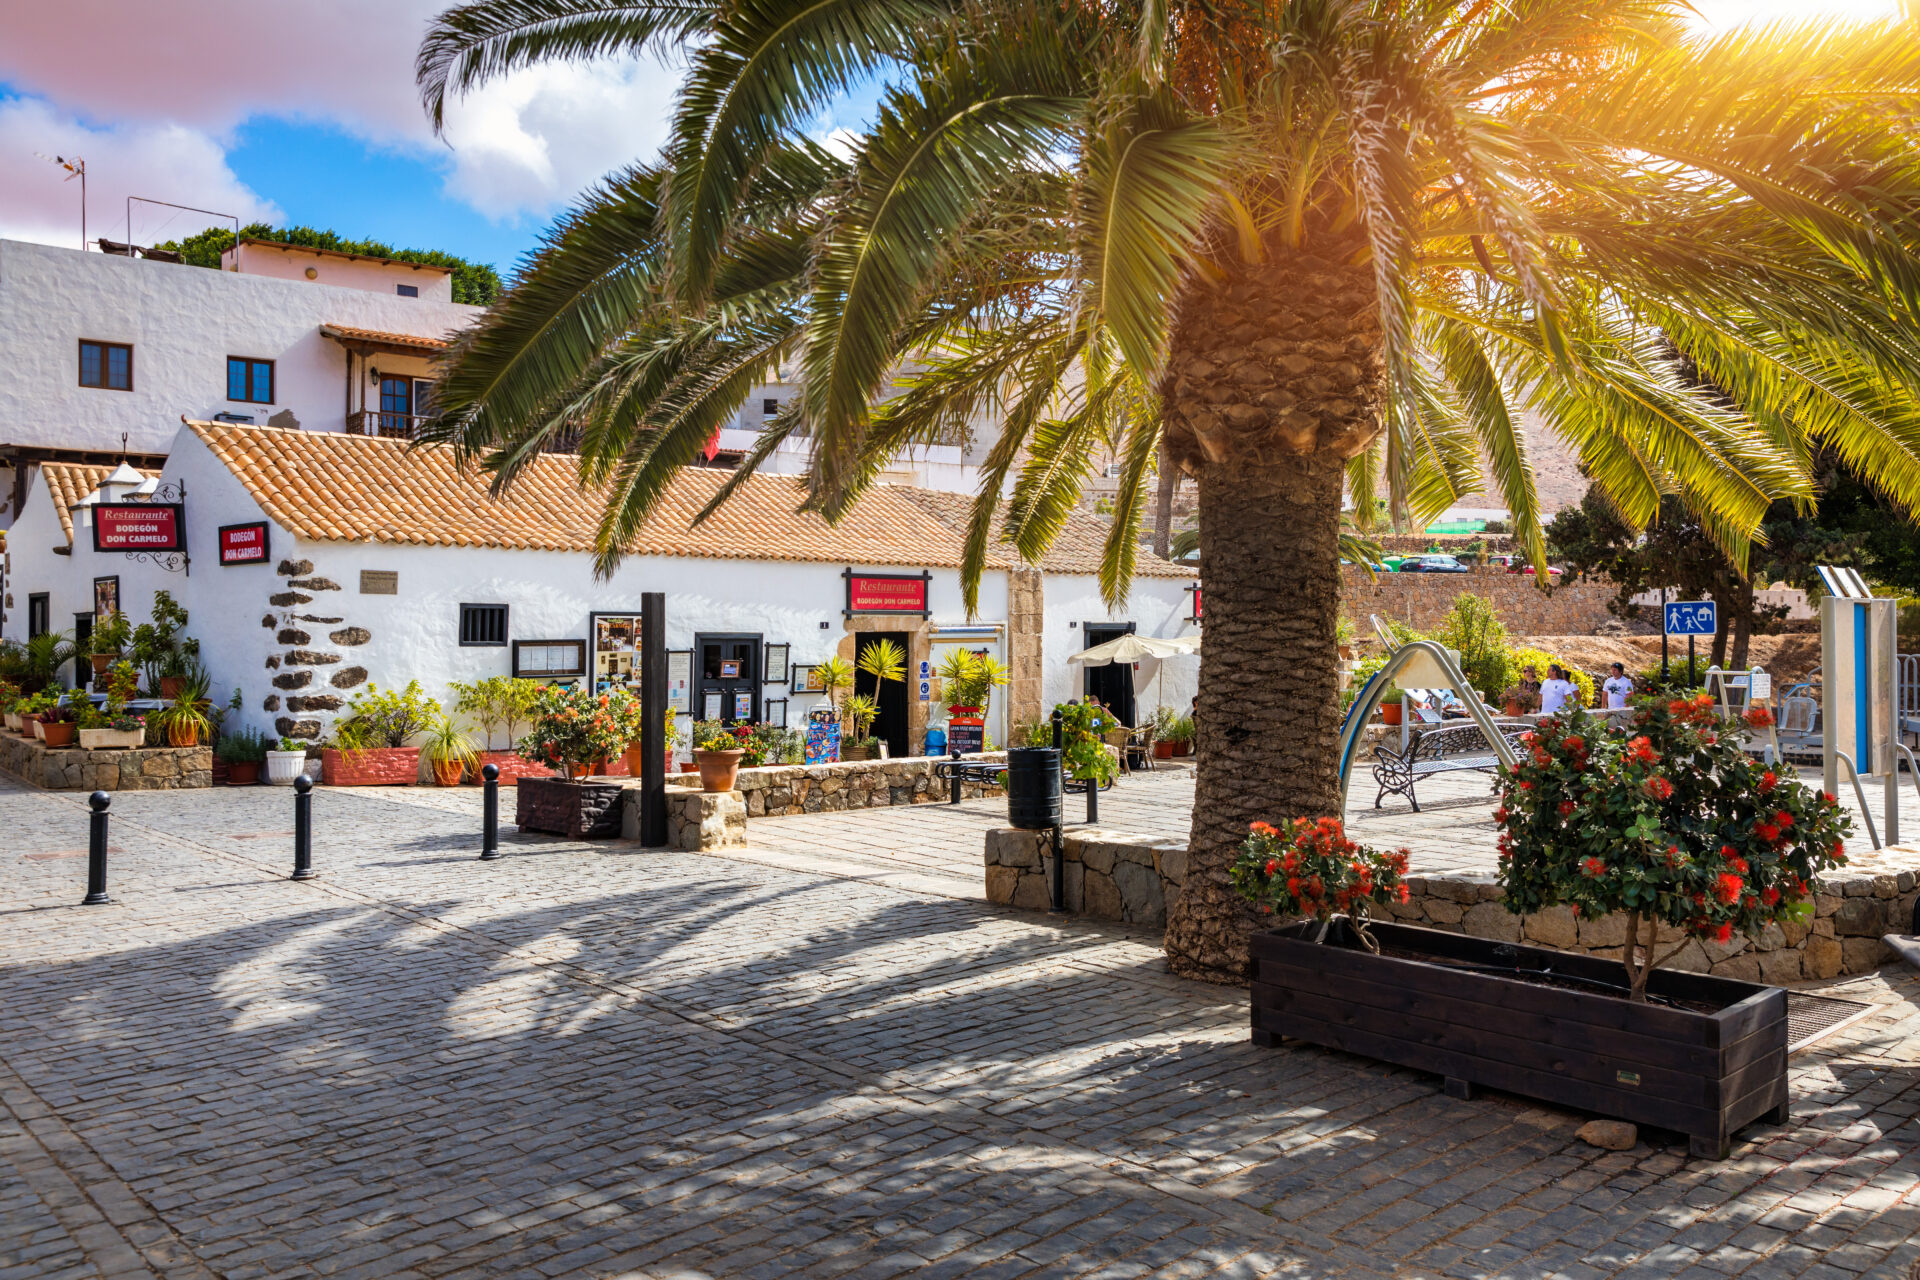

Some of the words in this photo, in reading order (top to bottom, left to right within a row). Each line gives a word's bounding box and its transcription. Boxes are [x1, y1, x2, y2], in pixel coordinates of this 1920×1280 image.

[104, 509, 169, 520] Restaurante
[115, 523, 158, 532] BODEGÓN
[106, 535, 126, 543] DON
[128, 535, 168, 543] CARMELO
[230, 528, 256, 543] BODEGÓN
[225, 548, 237, 560] DON
[237, 546, 262, 559] CARMELO
[860, 580, 917, 593] Restaurante
[896, 598, 921, 606] CARMELO
